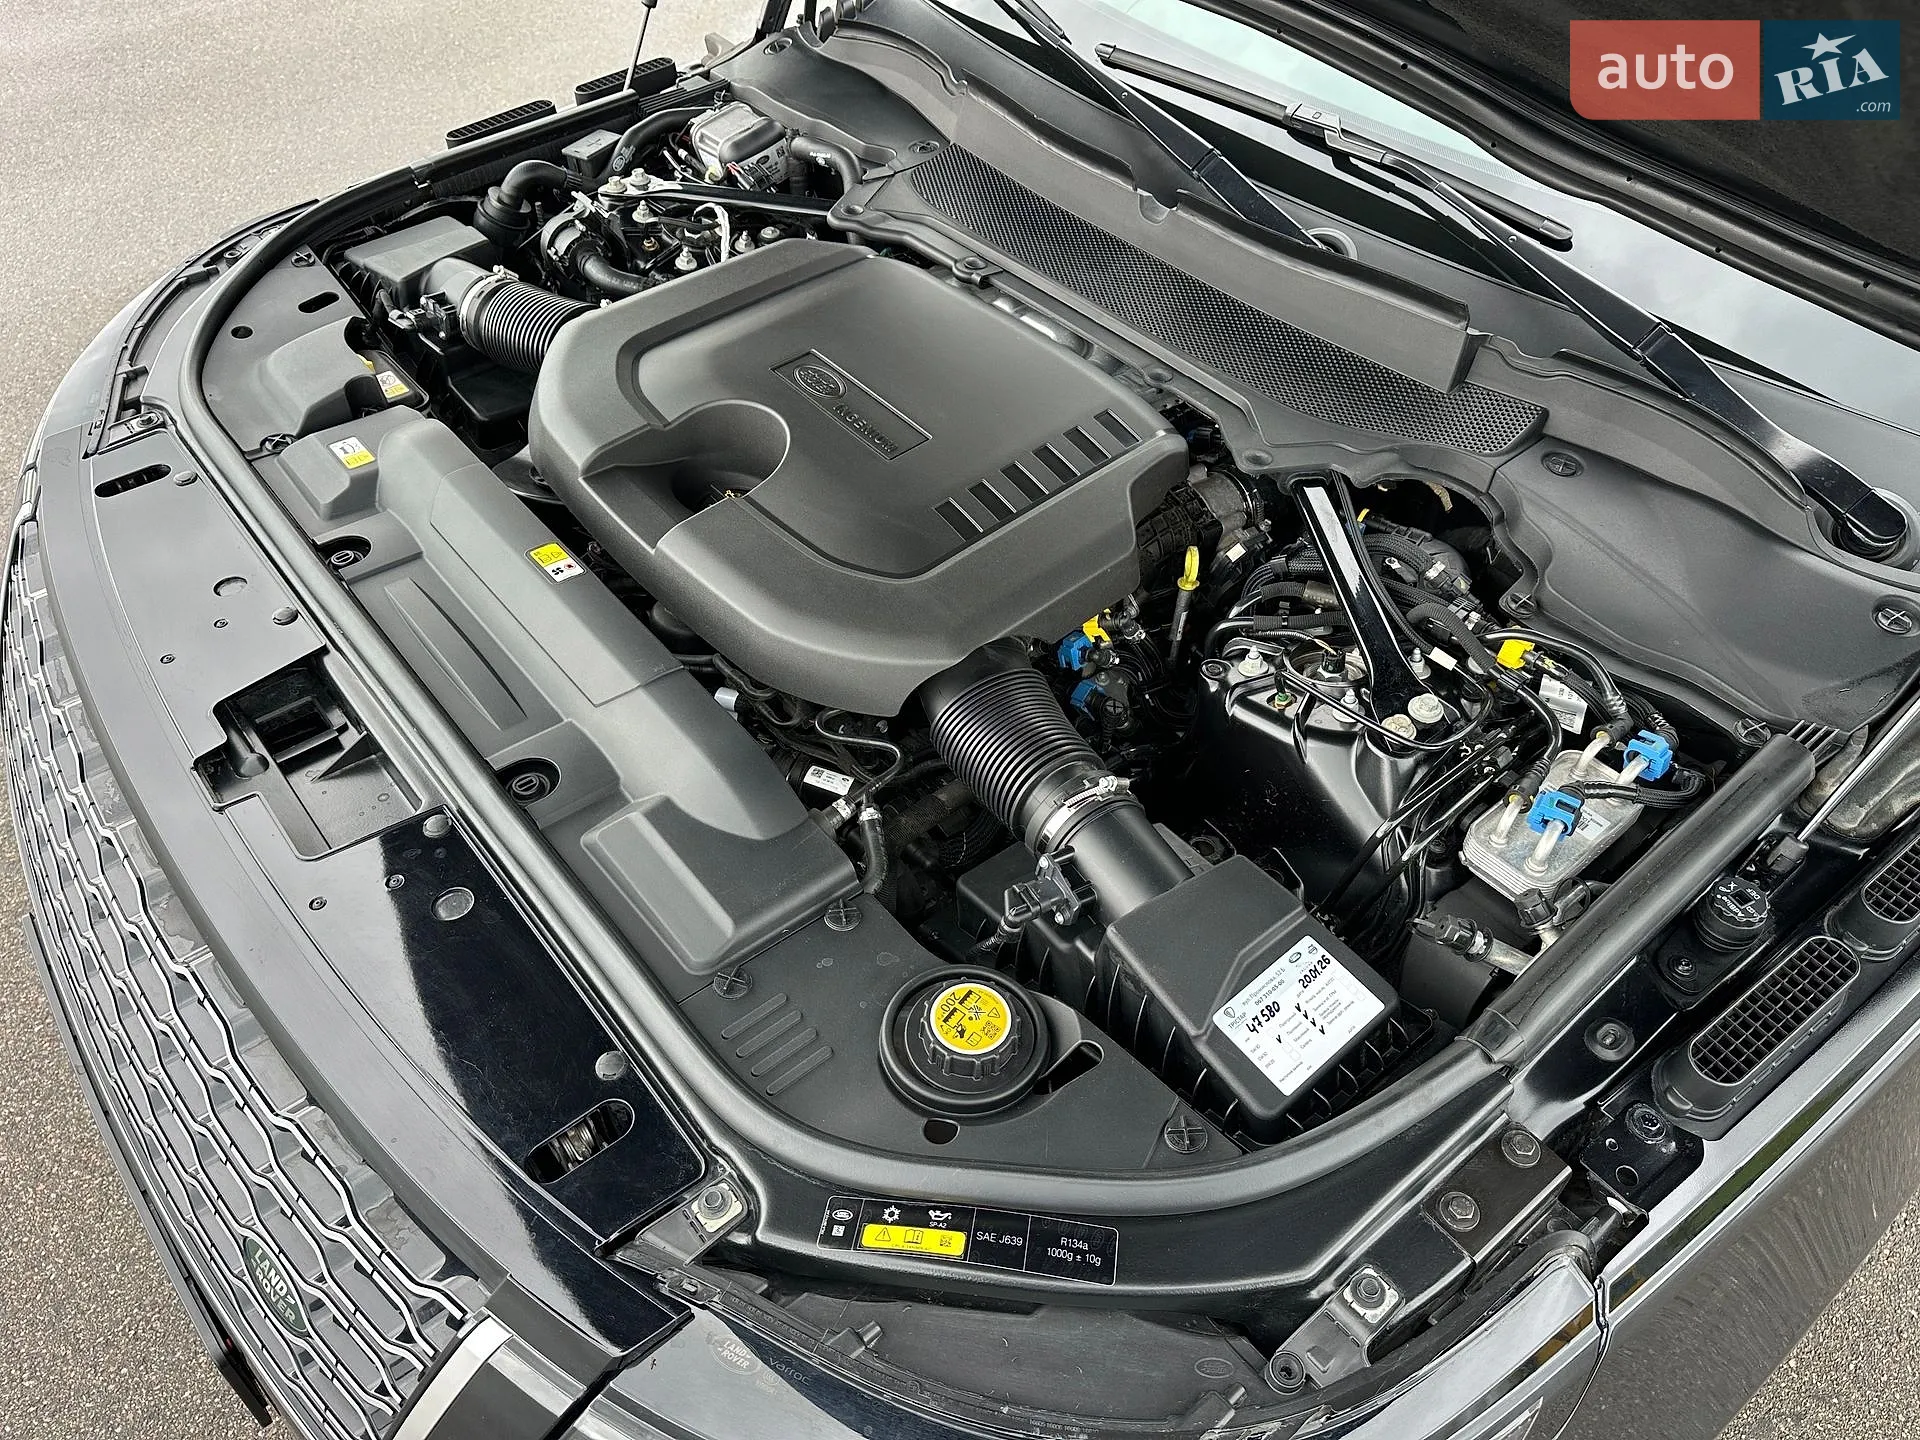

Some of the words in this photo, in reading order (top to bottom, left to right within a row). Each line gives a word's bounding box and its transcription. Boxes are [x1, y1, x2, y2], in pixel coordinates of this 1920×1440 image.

[976, 1231, 997, 1244] SAE
[999, 1233, 1023, 1247] J639
[1060, 1237, 1088, 1251] R134a
[1047, 1247, 1073, 1262] 1000g
[1084, 1253, 1101, 1267] 10g
[255, 1248, 288, 1297] LAND
[256, 1265, 296, 1324] ROVER
[723, 1340, 748, 1357] LAND
[720, 1350, 750, 1369] ROVER
[769, 1357, 812, 1386] varroc
